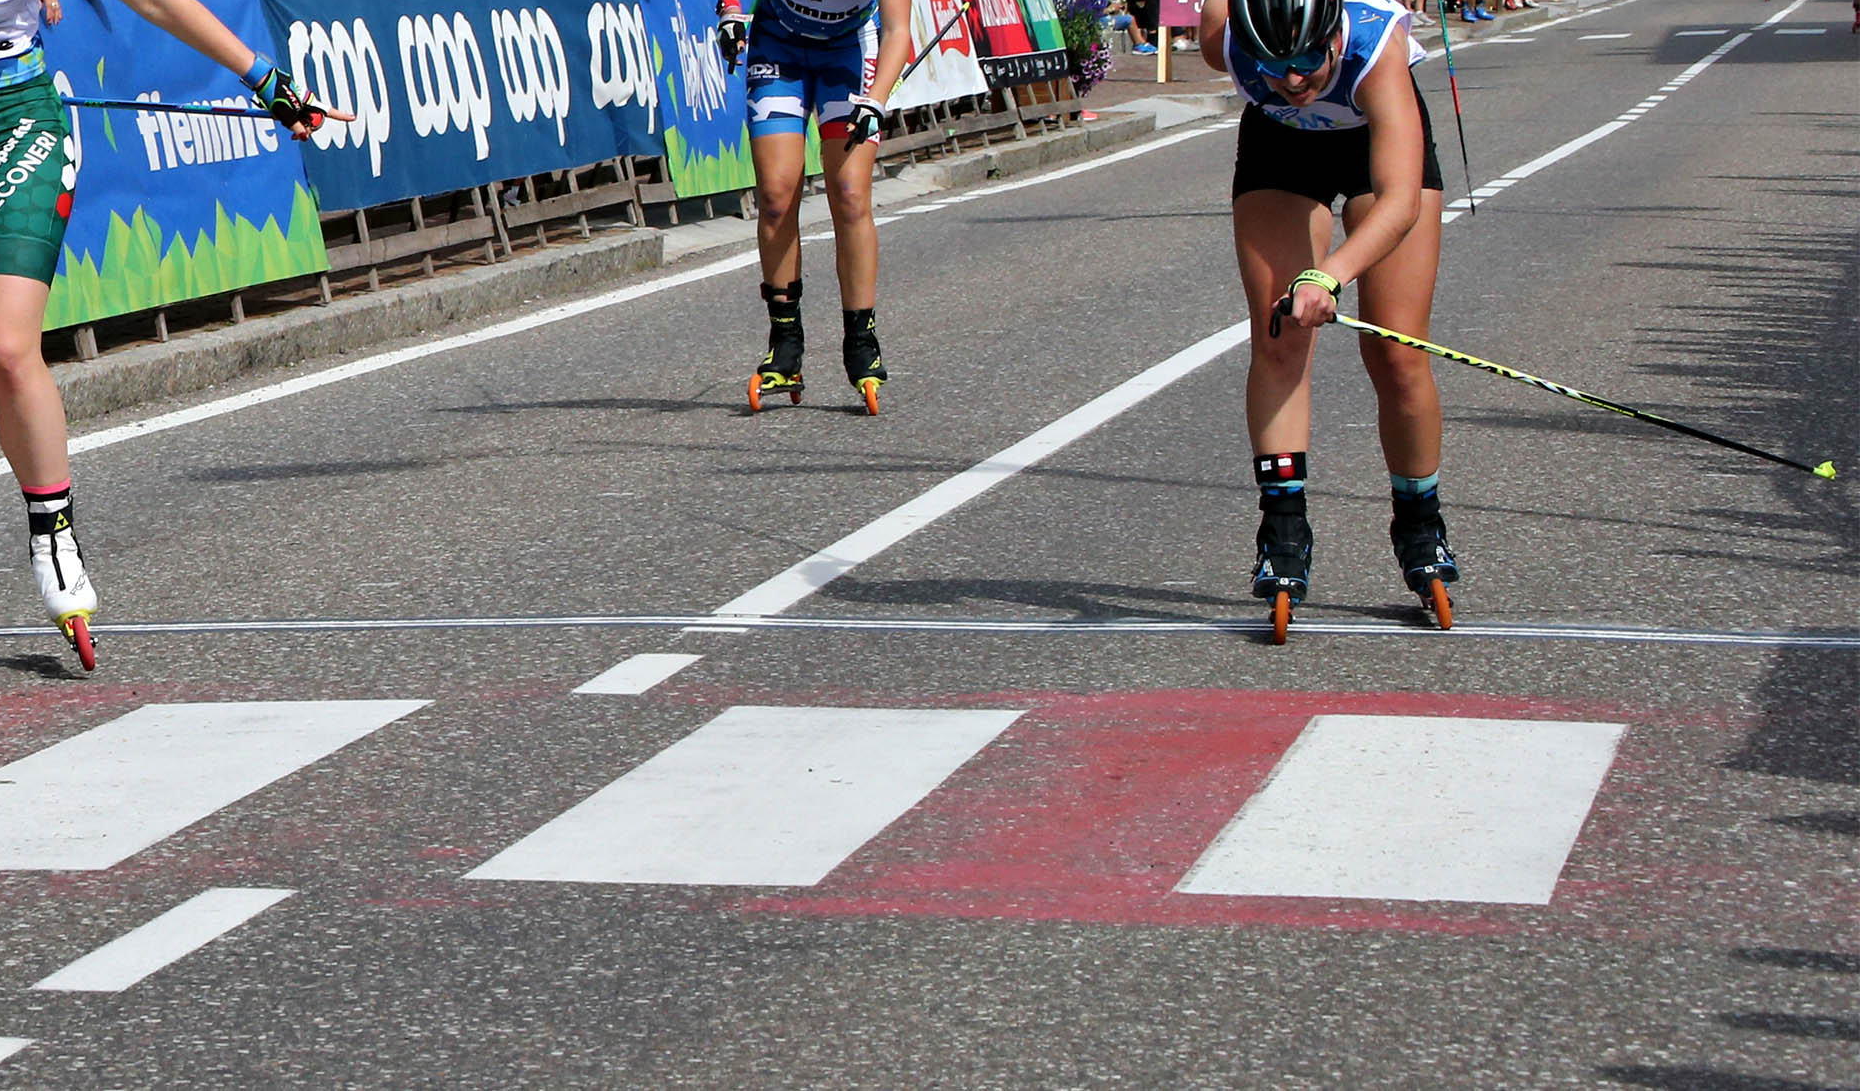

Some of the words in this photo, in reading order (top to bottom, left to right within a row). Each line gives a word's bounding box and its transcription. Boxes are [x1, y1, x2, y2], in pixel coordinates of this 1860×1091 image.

[288, 17, 390, 179] coop
[398, 11, 491, 161] coop
[491, 6, 570, 147] coop
[587, 2, 659, 135] coop
